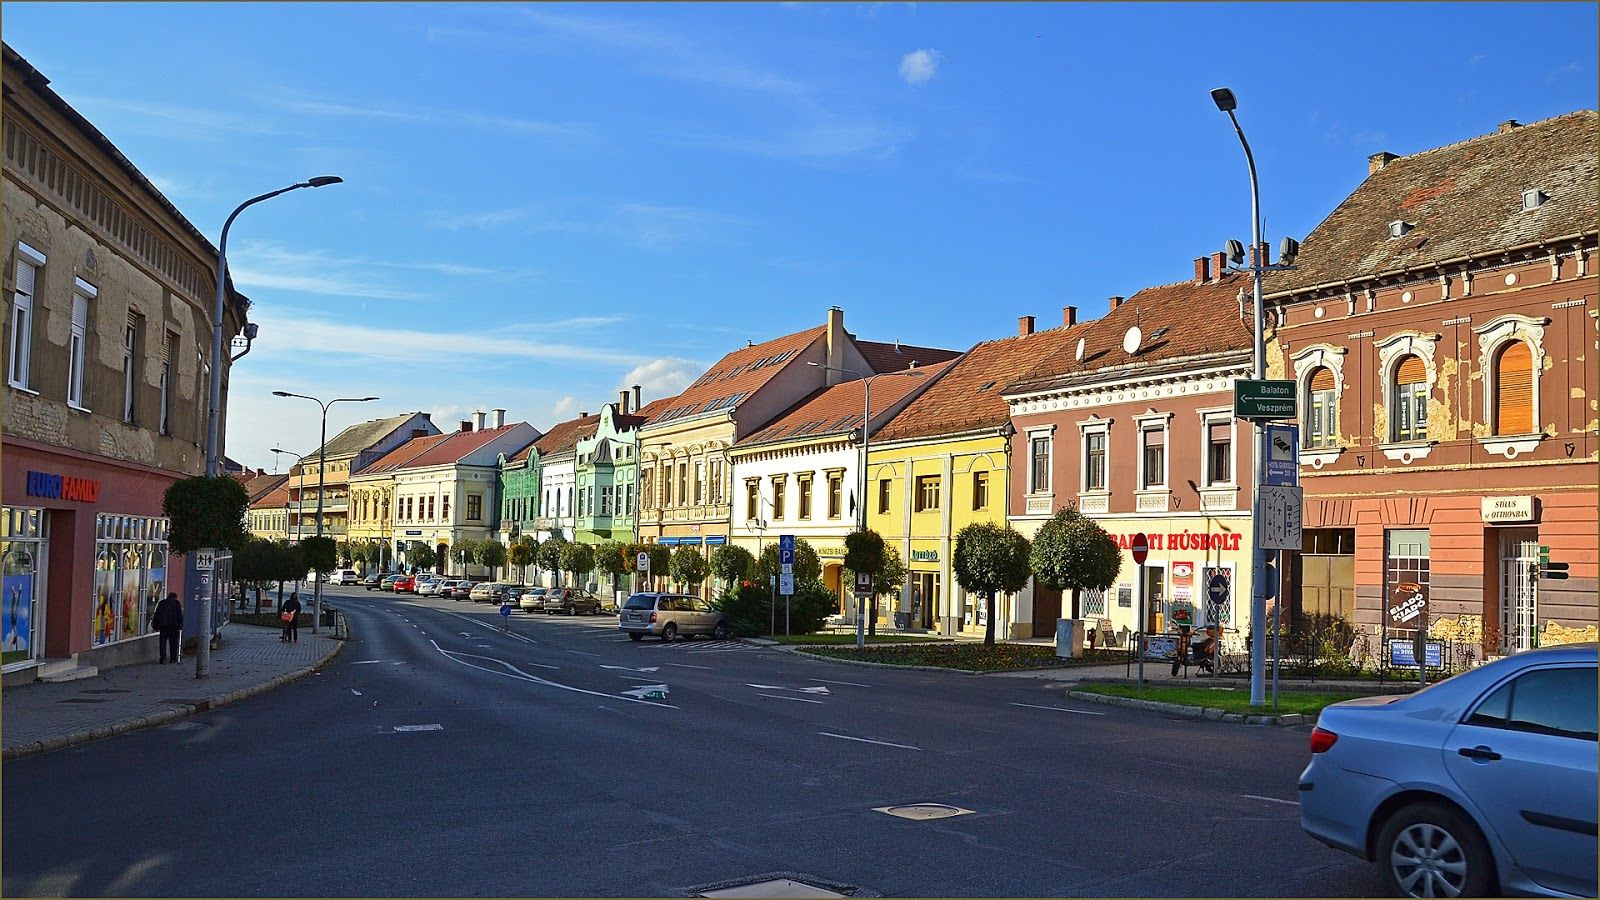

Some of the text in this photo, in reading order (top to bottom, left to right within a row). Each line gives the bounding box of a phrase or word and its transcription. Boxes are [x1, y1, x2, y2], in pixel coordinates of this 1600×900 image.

[1260, 385, 1290, 395] Balaton
[1256, 403, 1294, 413] Veszprém
[1491, 510, 1528, 519] OTTHONBAN
[1167, 529, 1243, 551] HÚSBOLT
[783, 551, 791, 562] P
